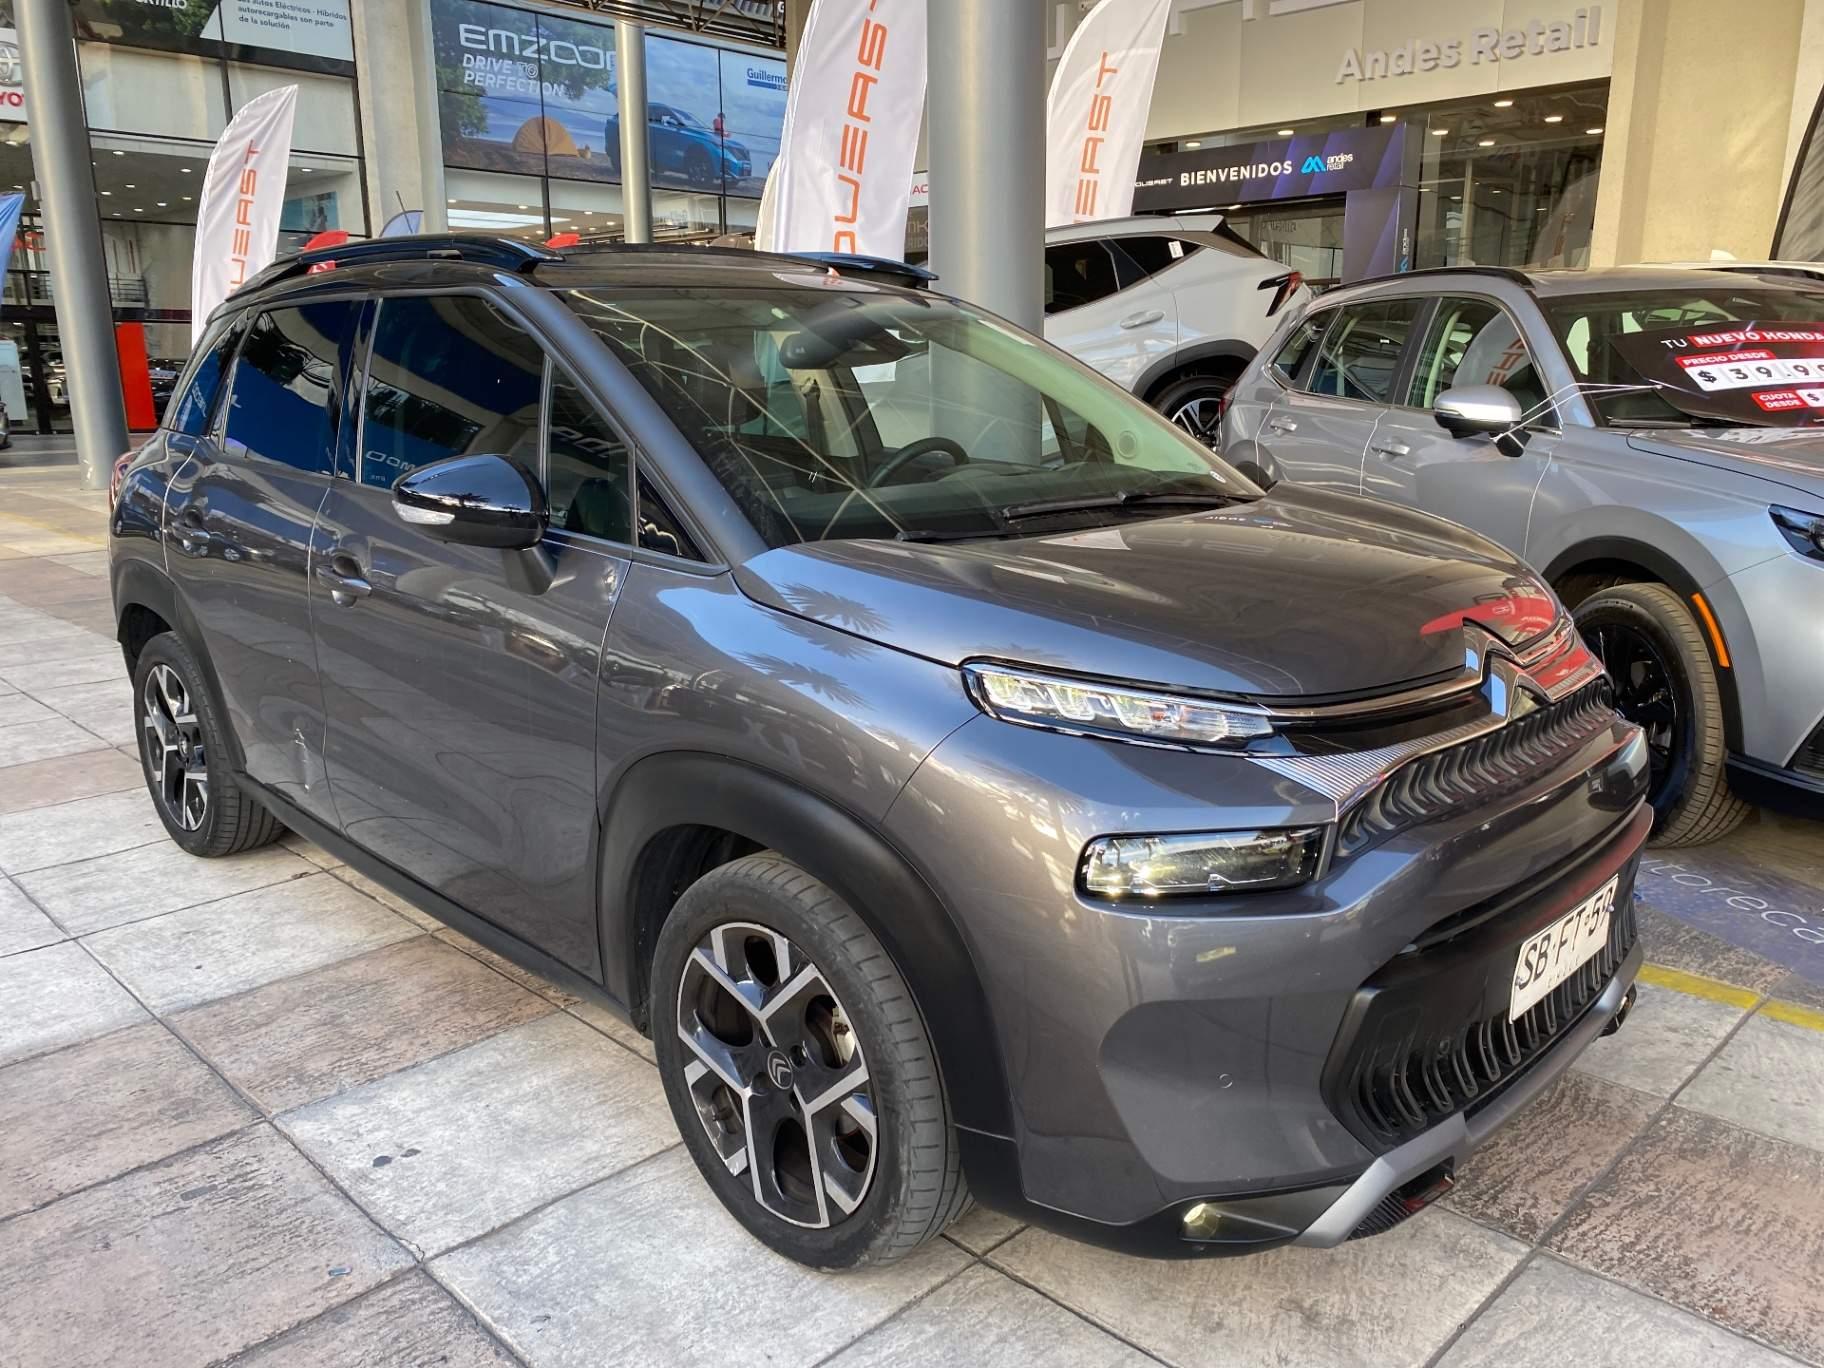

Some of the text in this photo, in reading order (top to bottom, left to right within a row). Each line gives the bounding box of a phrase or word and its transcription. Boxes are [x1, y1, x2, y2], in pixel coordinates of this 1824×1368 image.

[239, 14, 249, 23] de
[1336, 6, 1603, 84] Andes Retail
[463, 54, 513, 74] DRIVE
[464, 71, 564, 97] PERFECTION
[1073, 51, 1118, 223] EAST
[1180, 160, 1293, 187] BIENVENIDOS
[1661, 339, 1688, 349] TU
[1694, 330, 1760, 345] NUEVO
[1682, 351, 1770, 366] PRECIO DESDE
[1759, 393, 1798, 401] CUOTA
[1765, 400, 1803, 409] DESDE
